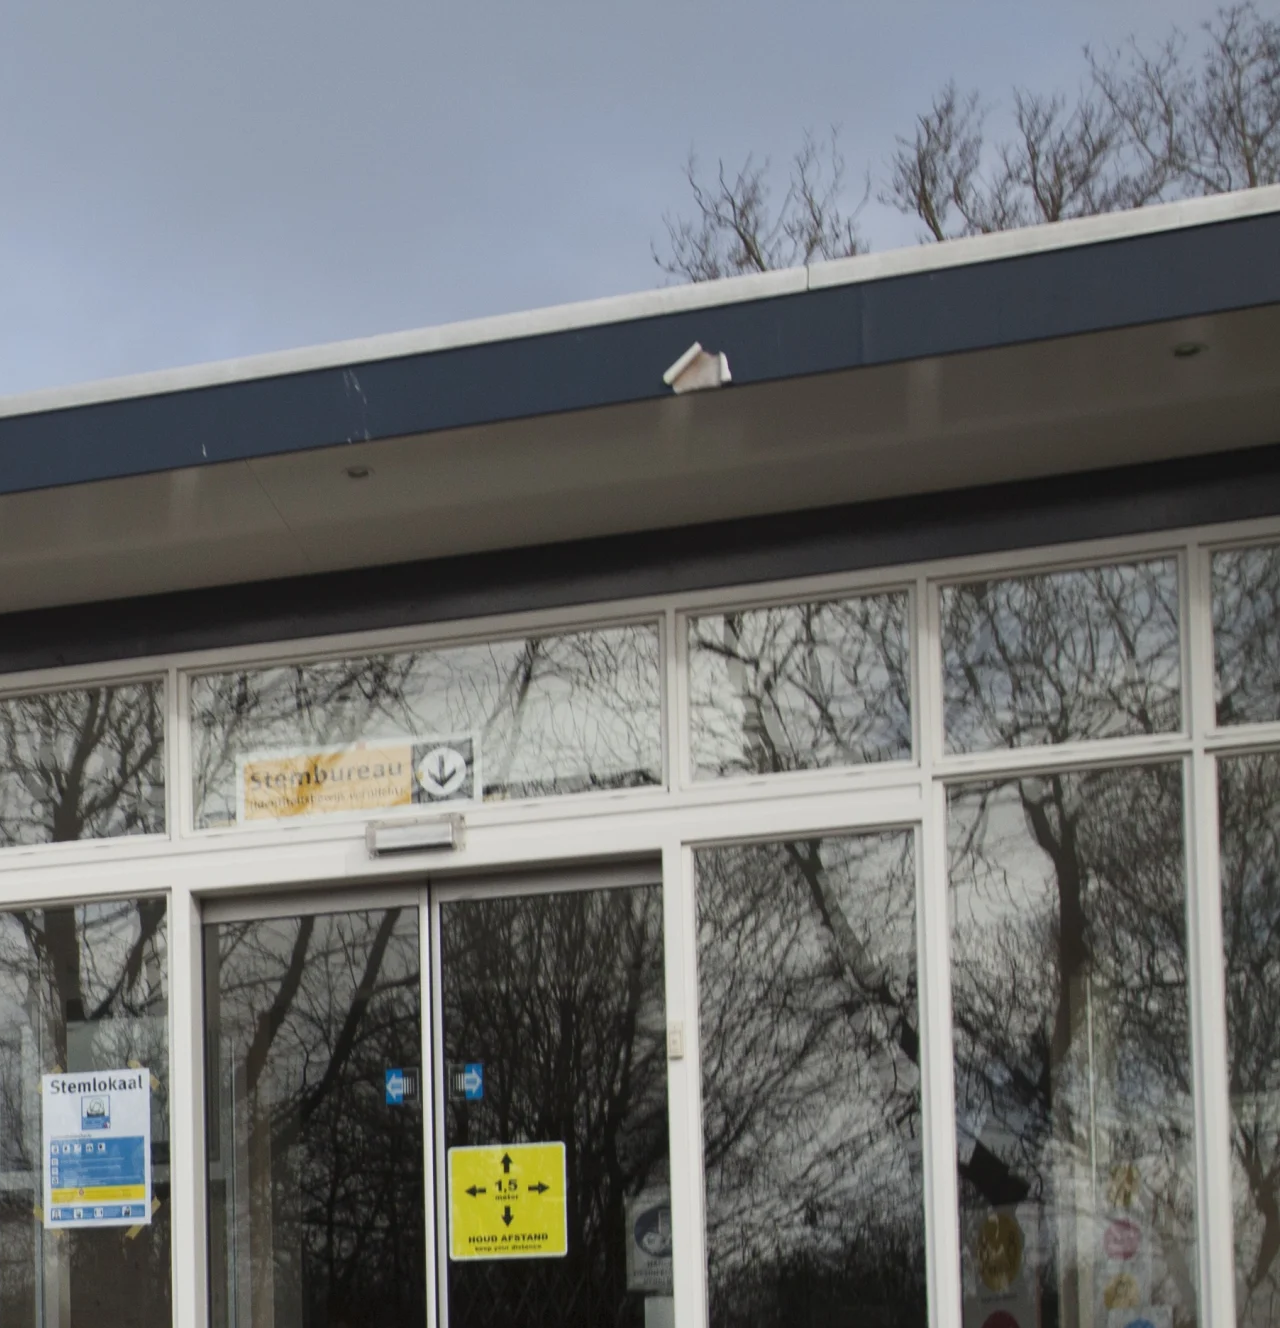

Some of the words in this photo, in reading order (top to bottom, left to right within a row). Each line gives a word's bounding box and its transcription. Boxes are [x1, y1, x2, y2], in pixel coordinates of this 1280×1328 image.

[250, 761, 403, 790] Stembureau
[50, 1074, 143, 1094] Stemlokaal
[494, 1178, 519, 1194] 1,5
[495, 1193, 519, 1201] meter
[468, 1234, 498, 1244] HOUD
[501, 1232, 549, 1243] AFSTAND
